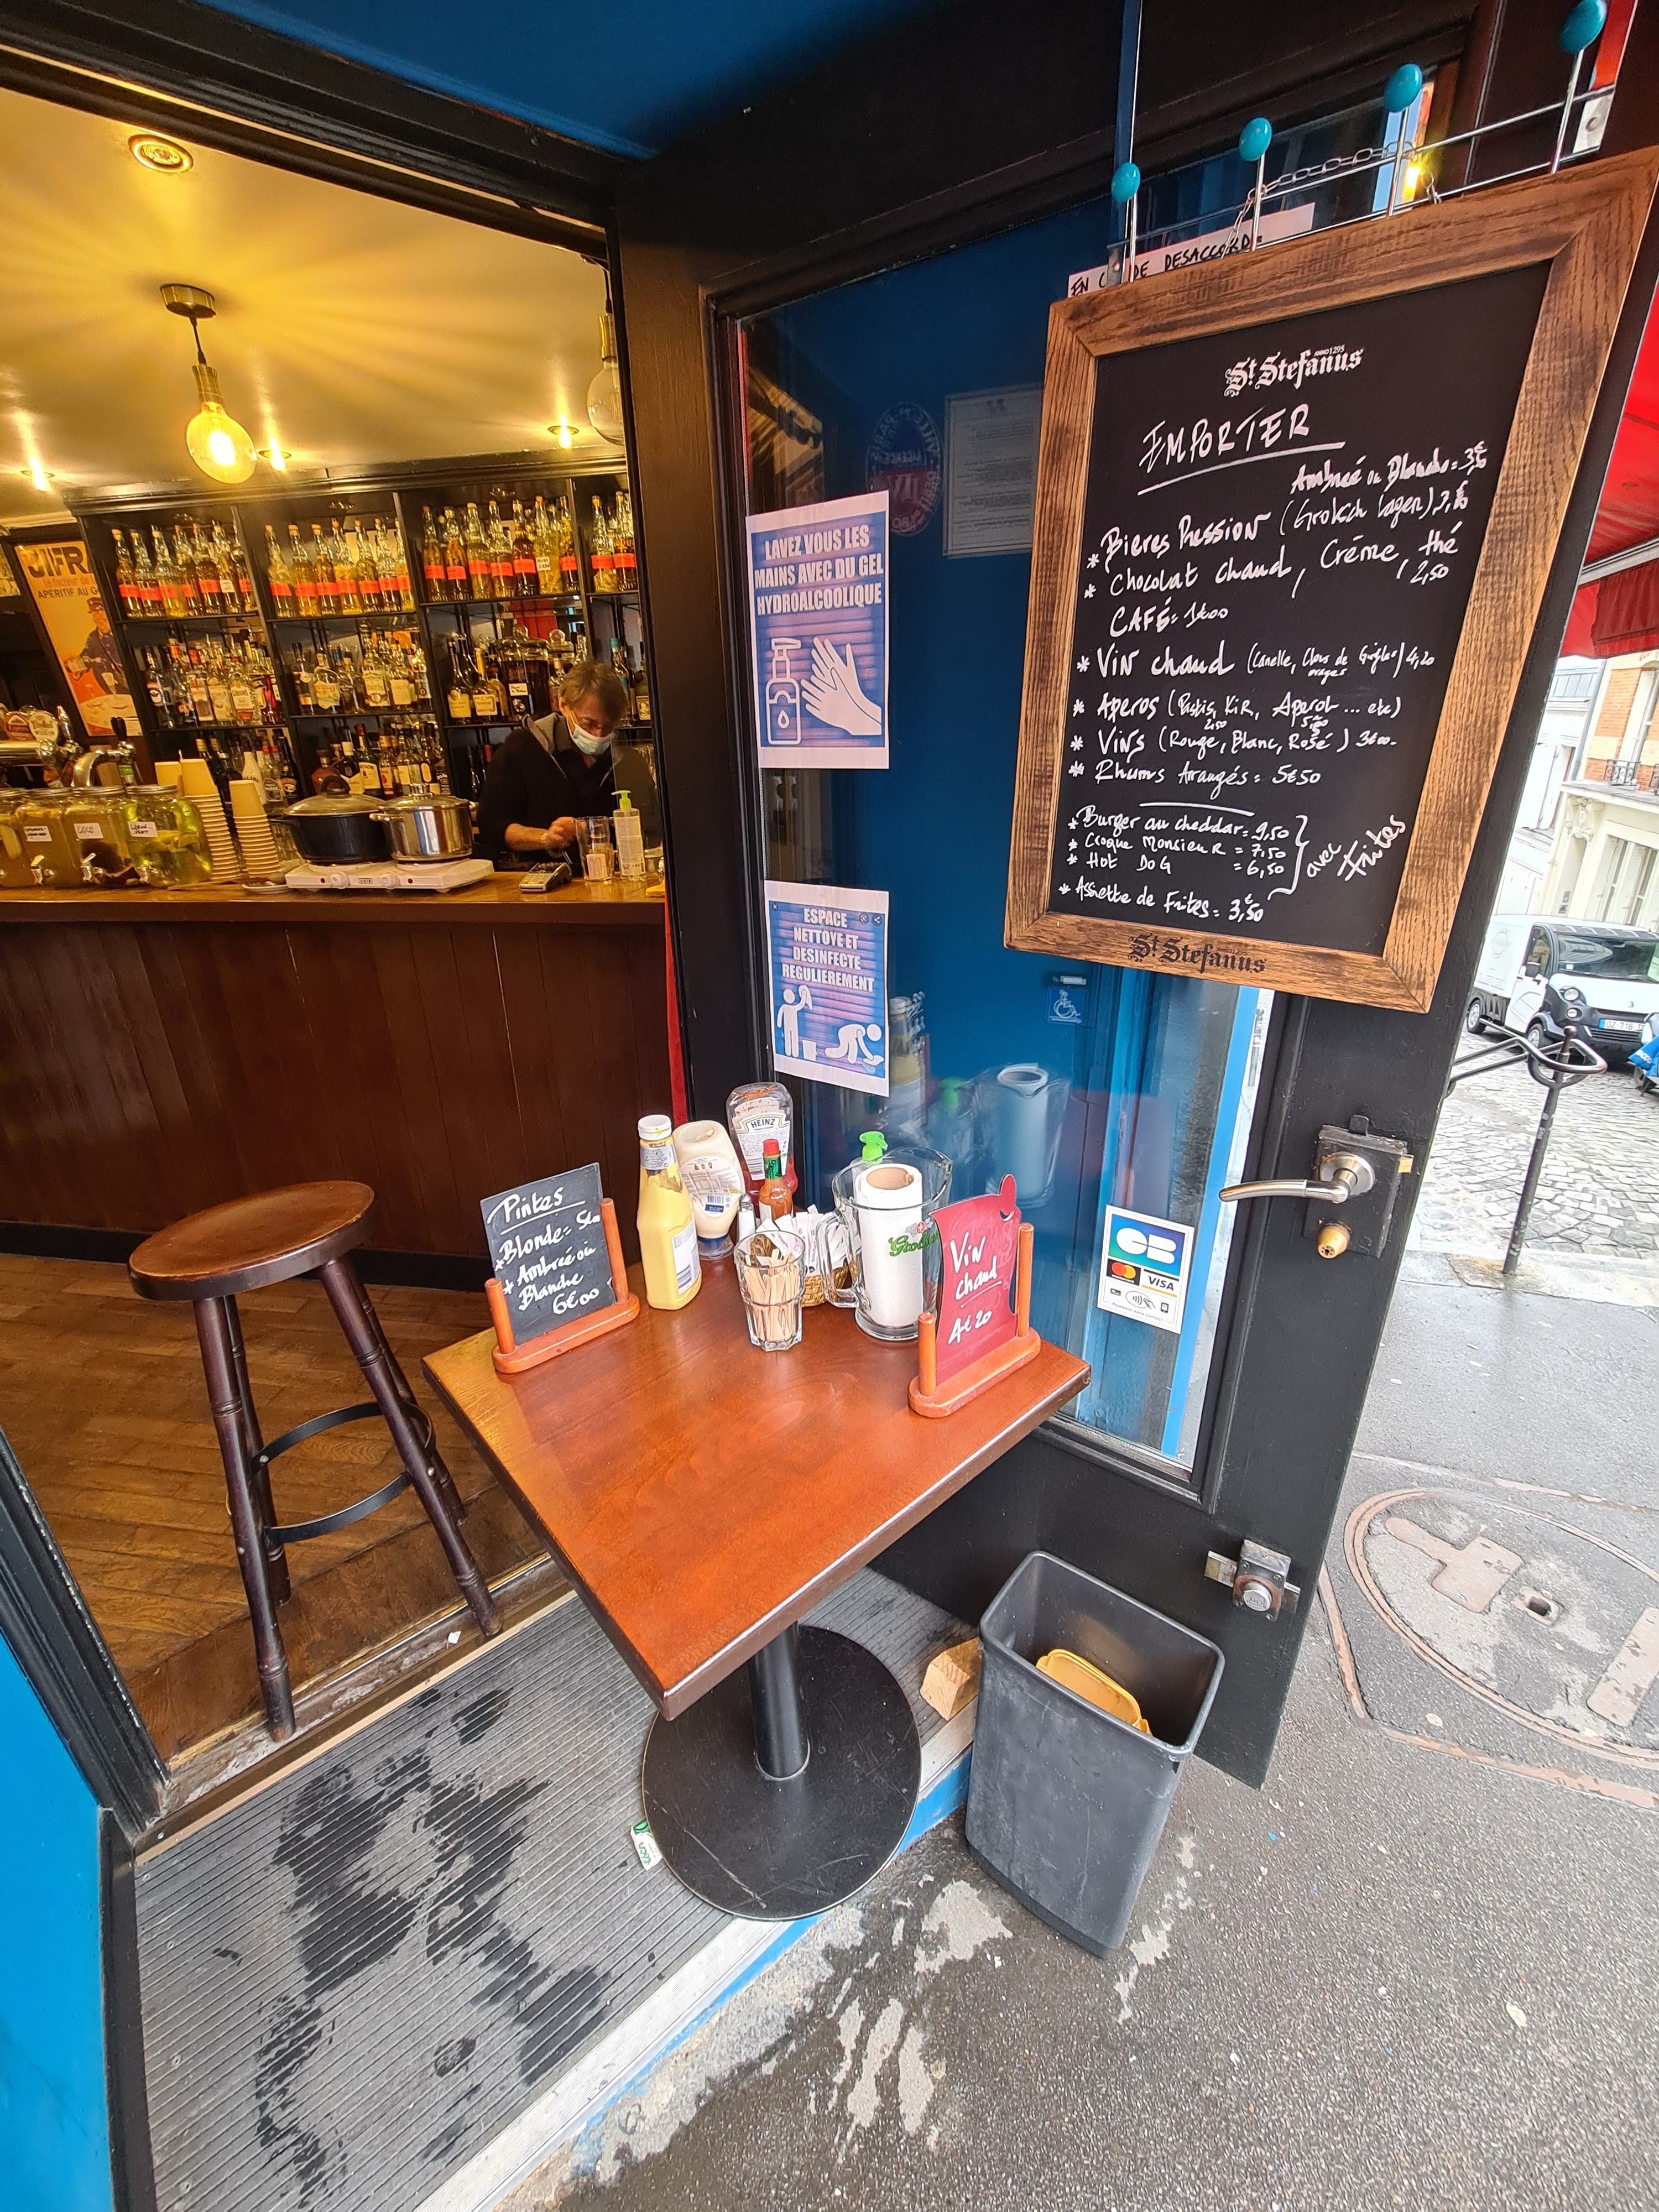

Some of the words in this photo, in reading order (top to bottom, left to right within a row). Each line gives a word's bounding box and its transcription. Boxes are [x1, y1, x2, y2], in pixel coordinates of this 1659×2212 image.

[1254, 348, 1364, 389] Stefanus
[765, 535, 801, 560] LAVEZ
[804, 529, 842, 555] VOUS
[844, 525, 870, 549] LES
[28, 546, 93, 578] JIFR
[754, 565, 796, 589] MAINS
[798, 560, 832, 584] AVEC
[835, 556, 855, 580] DU
[859, 553, 884, 577] GEL
[38, 588, 74, 599] APERITIF
[77, 587, 88, 596] AU
[757, 583, 882, 615] HYDROALCOOLIQUE
[1151, 639, 1235, 677] chaud
[1334, 647, 1348, 666] de
[1076, 805, 1141, 837] Burger
[1145, 817, 1170, 831] au
[1084, 832, 1134, 855] Croque
[1086, 852, 1118, 869] Hot
[1307, 843, 1342, 878] avec
[1074, 875, 1131, 901] Assiette
[1136, 885, 1156, 907] de
[804, 907, 847, 928] ESPACE
[794, 927, 844, 947] NETTOYE
[846, 933, 859, 950] ET
[793, 946, 861, 971] DESINFECTE
[1158, 937, 1267, 974] Stefanus
[782, 963, 874, 993] REGULIEREMENT
[750, 1118, 775, 1129] HEINZ
[487, 1187, 564, 1224] Pintes
[518, 1272, 584, 1311] Blanche
[955, 1255, 997, 1300] chaud
[1147, 1275, 1174, 1291] VISA
